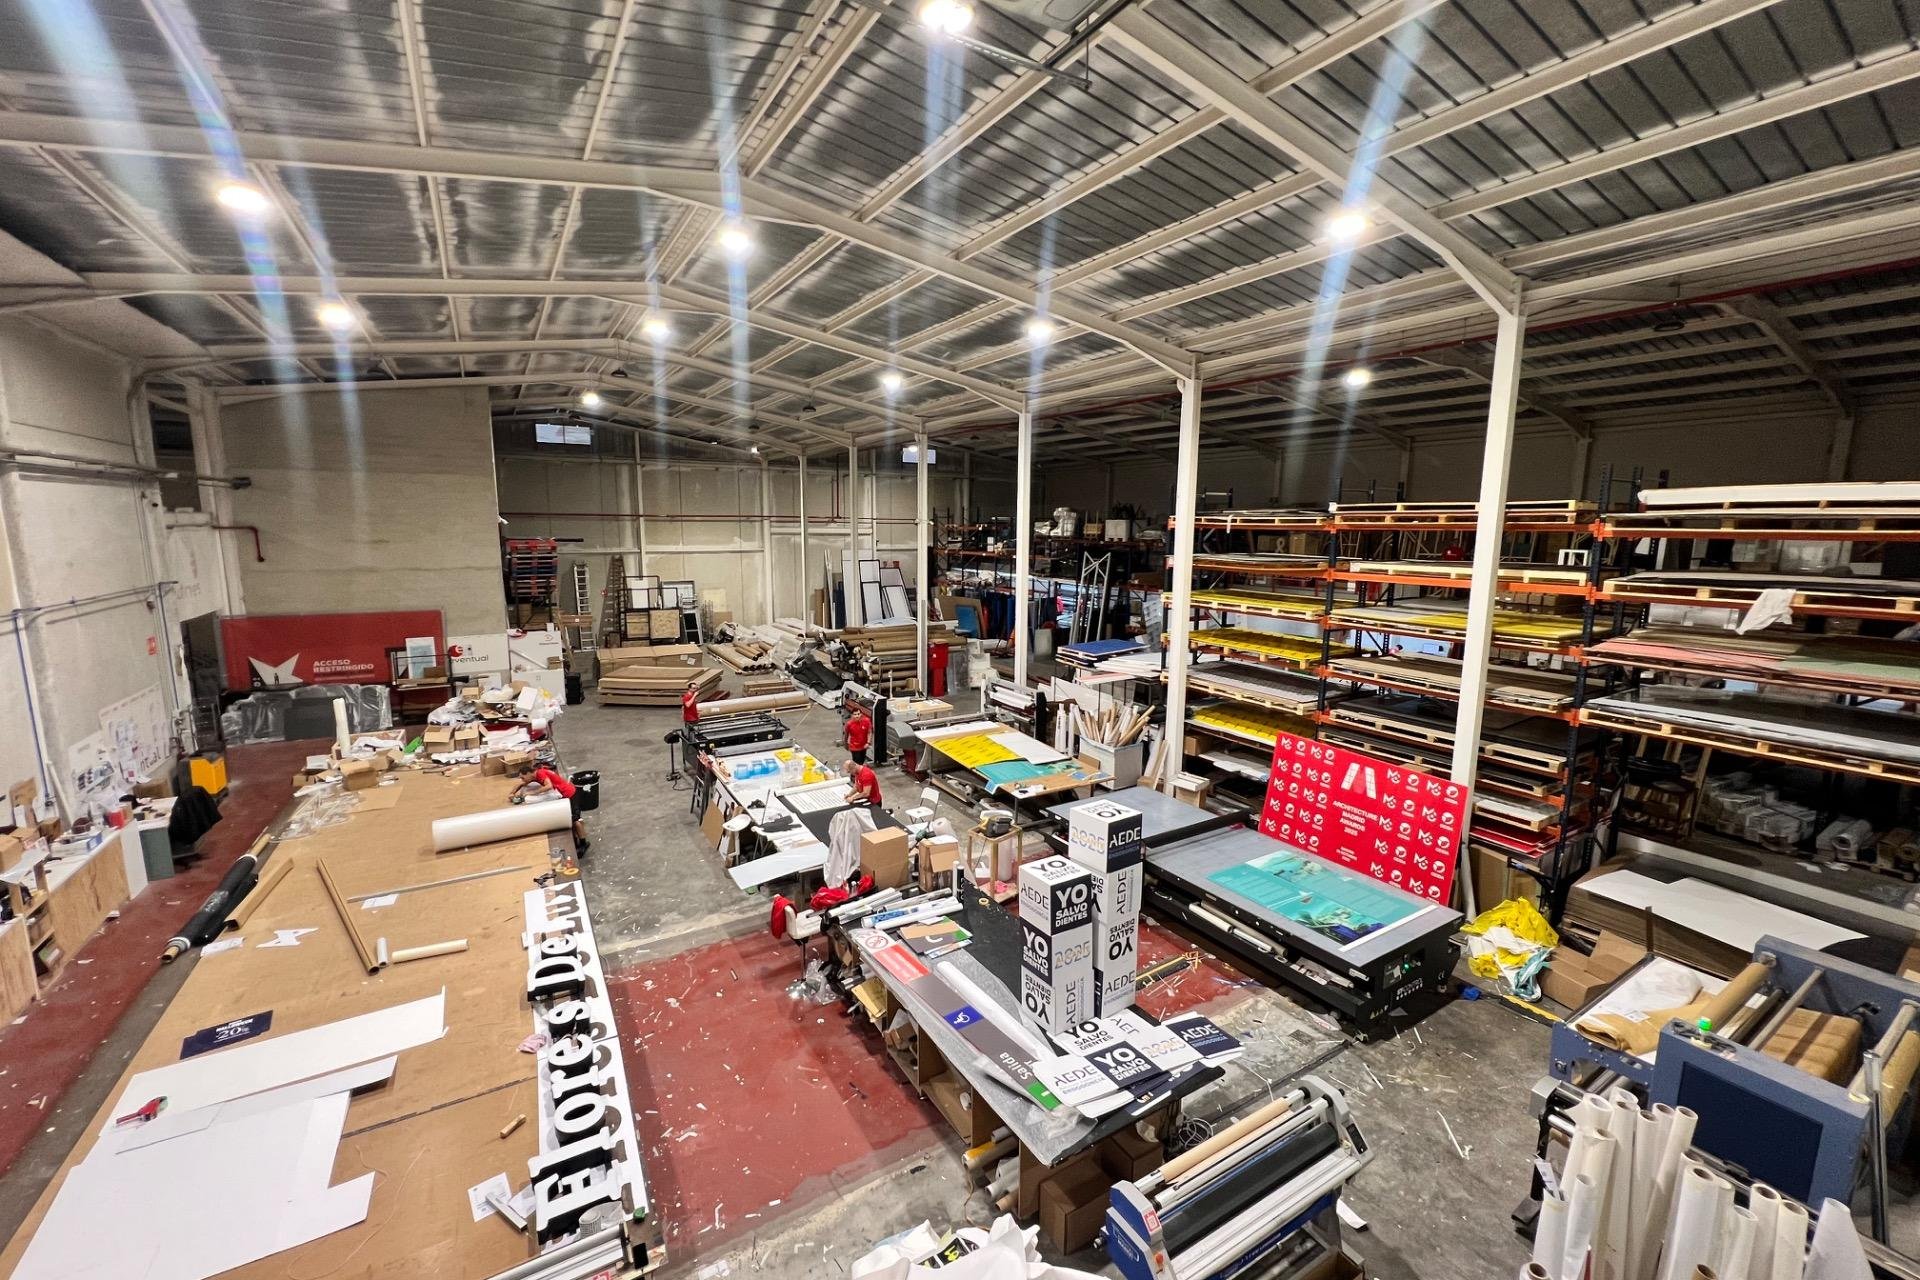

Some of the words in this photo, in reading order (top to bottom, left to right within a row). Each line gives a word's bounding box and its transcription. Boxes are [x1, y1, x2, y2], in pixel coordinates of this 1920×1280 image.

[313, 659, 351, 667] ACCESO
[313, 663, 375, 673] RESTRINGIDO
[1332, 800, 1378, 822] ARCHITECTURE
[1342, 811, 1366, 824] MADRID
[1339, 817, 1366, 832] AWARDS
[1108, 826, 1142, 849] AEDE
[1031, 860, 1067, 872] YO
[1021, 882, 1050, 910] AEDE
[1055, 883, 1088, 909] YO
[1116, 870, 1127, 915] AEDE
[1055, 902, 1088, 920] SALVO
[1055, 910, 1088, 928] DIENTES
[1109, 917, 1136, 934] DIENTES
[1109, 925, 1136, 943] SALVO
[1022, 925, 1049, 958] YO
[1108, 936, 1134, 961] YO
[1022, 953, 1049, 977] DIENTES
[1023, 945, 1049, 969] SALVO
[1025, 973, 1052, 996] DIENTES
[1025, 980, 1051, 1005] SALVO
[1104, 969, 1136, 996] AEDE
[1025, 992, 1051, 1025] YO
[1066, 980, 1076, 1025] AEDE
[1064, 1020, 1100, 1040] YO
[1073, 1029, 1109, 1048] SALVO
[1180, 1024, 1220, 1042] AEDE
[1079, 1034, 1115, 1051] DIENTES
[999, 1051, 1033, 1080] Salida
[1093, 1046, 1136, 1068] YO
[1108, 1057, 1147, 1076] SALVO
[1053, 1065, 1098, 1087] AEDE
[1114, 1063, 1153, 1082] DIENTES
[527, 1001, 624, 1245] Flores
